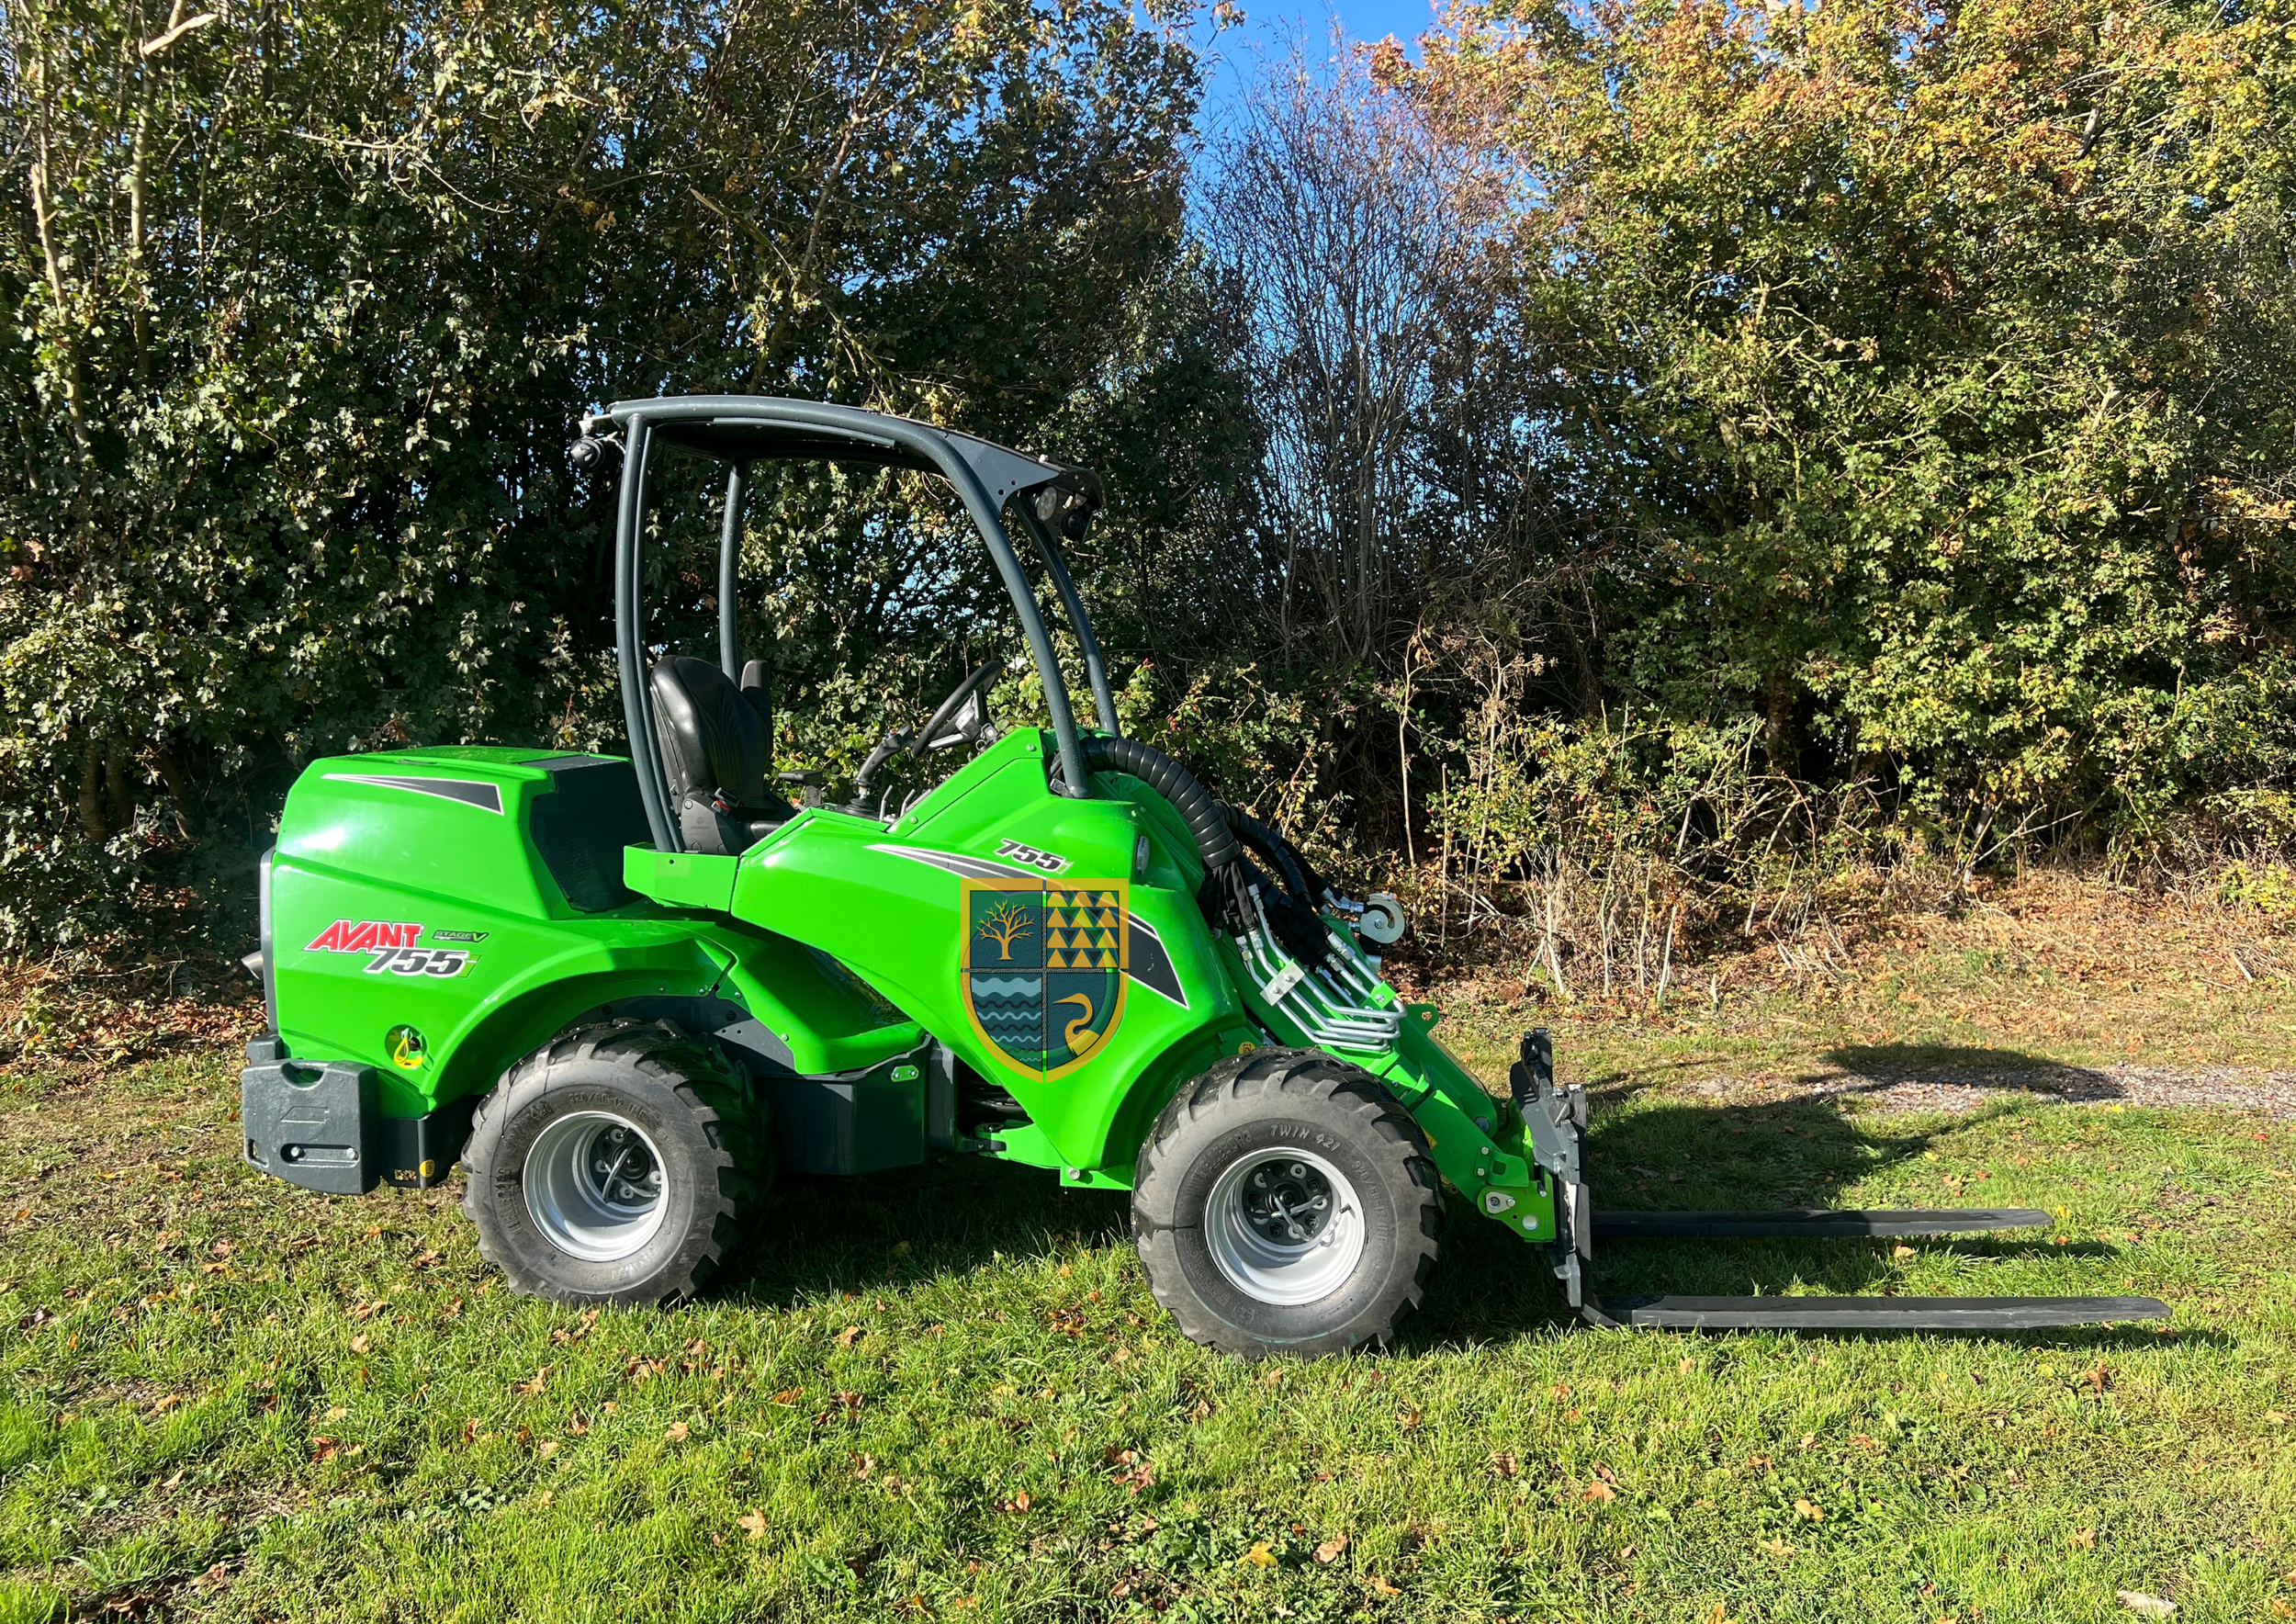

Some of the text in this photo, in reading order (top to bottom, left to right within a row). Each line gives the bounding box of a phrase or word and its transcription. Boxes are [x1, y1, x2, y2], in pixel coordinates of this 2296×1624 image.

[994, 838, 1074, 874] 755i
[303, 919, 422, 953] AVANT
[472, 931, 488, 942] V
[363, 947, 481, 978] 755i
[1270, 1123, 1310, 1140] TWIN
[1315, 1133, 1343, 1152] 421
